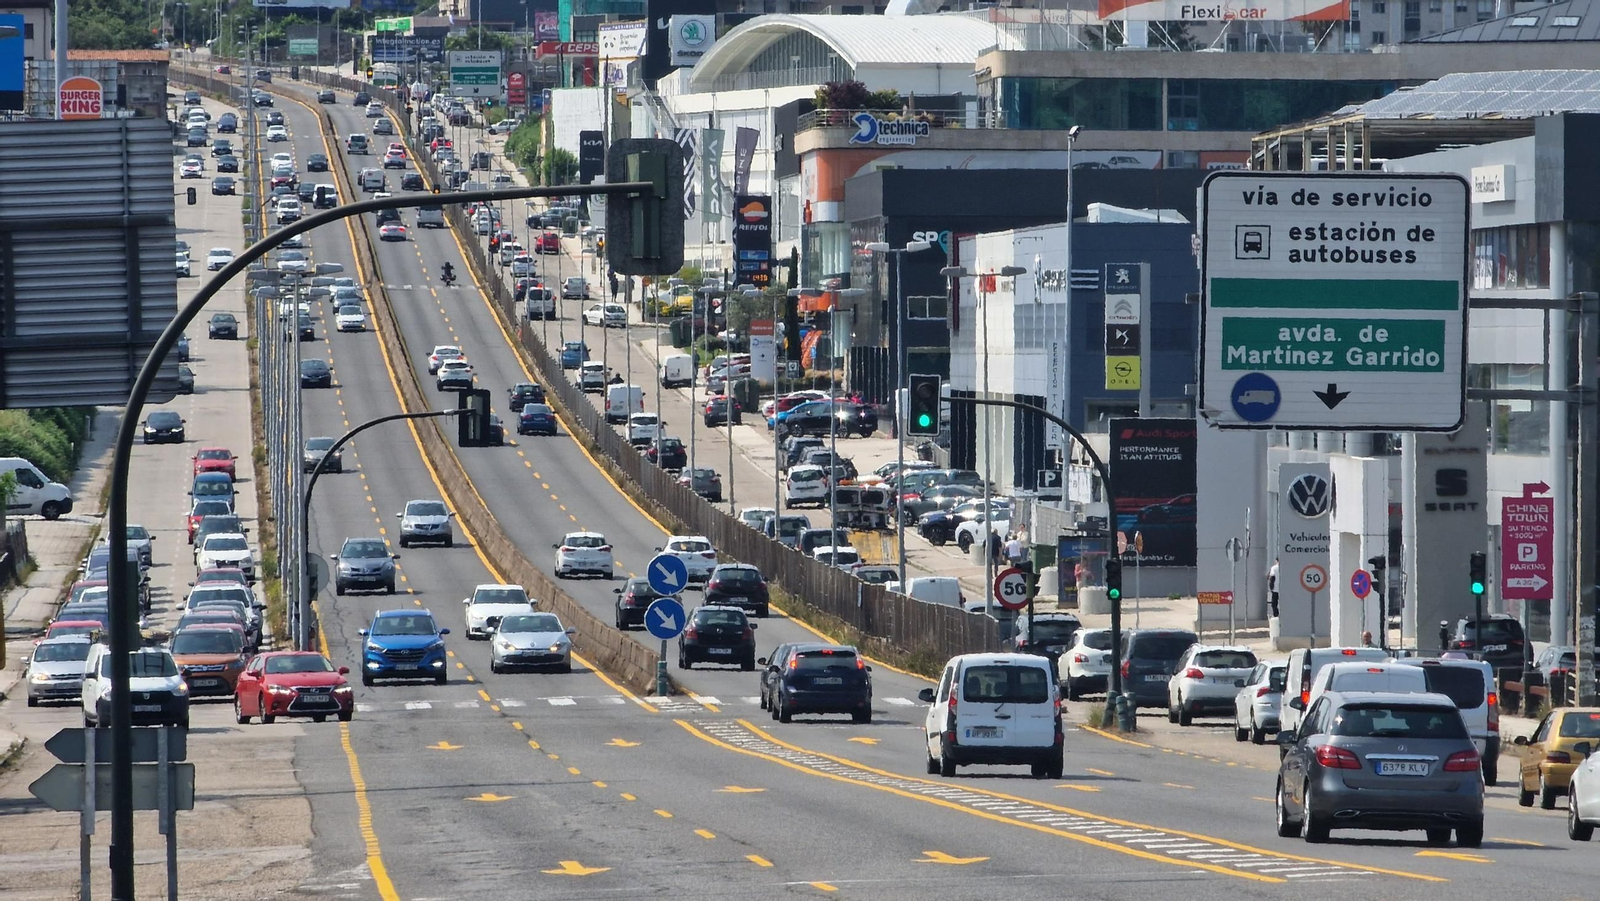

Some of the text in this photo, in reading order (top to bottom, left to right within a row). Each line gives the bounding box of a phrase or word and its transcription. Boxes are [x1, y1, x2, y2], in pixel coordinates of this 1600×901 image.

[1181, 5, 1267, 19] Flexi car
[567, 43, 599, 52] CEPS
[60, 91, 100, 100] BURGER
[60, 100, 100, 113] KING
[878, 119, 929, 136] technica
[1242, 185, 1432, 207] vía de servicio
[1289, 221, 1436, 242] estación de
[1289, 245, 1417, 263] autobuses
[1278, 324, 1389, 343] avda. de
[1227, 345, 1440, 366] Martínez Garrido
[1135, 429, 1162, 438] Audi
[1425, 502, 1479, 512] SEAT
[1507, 504, 1549, 513] CHINA
[1507, 513, 1549, 523] TOWN
[1523, 546, 1533, 559] P
[1509, 563, 1547, 571] PARKING
[1306, 573, 1321, 583] 50
[1004, 582, 1027, 596] 50
[1382, 763, 1427, 773] 6378 KLV
